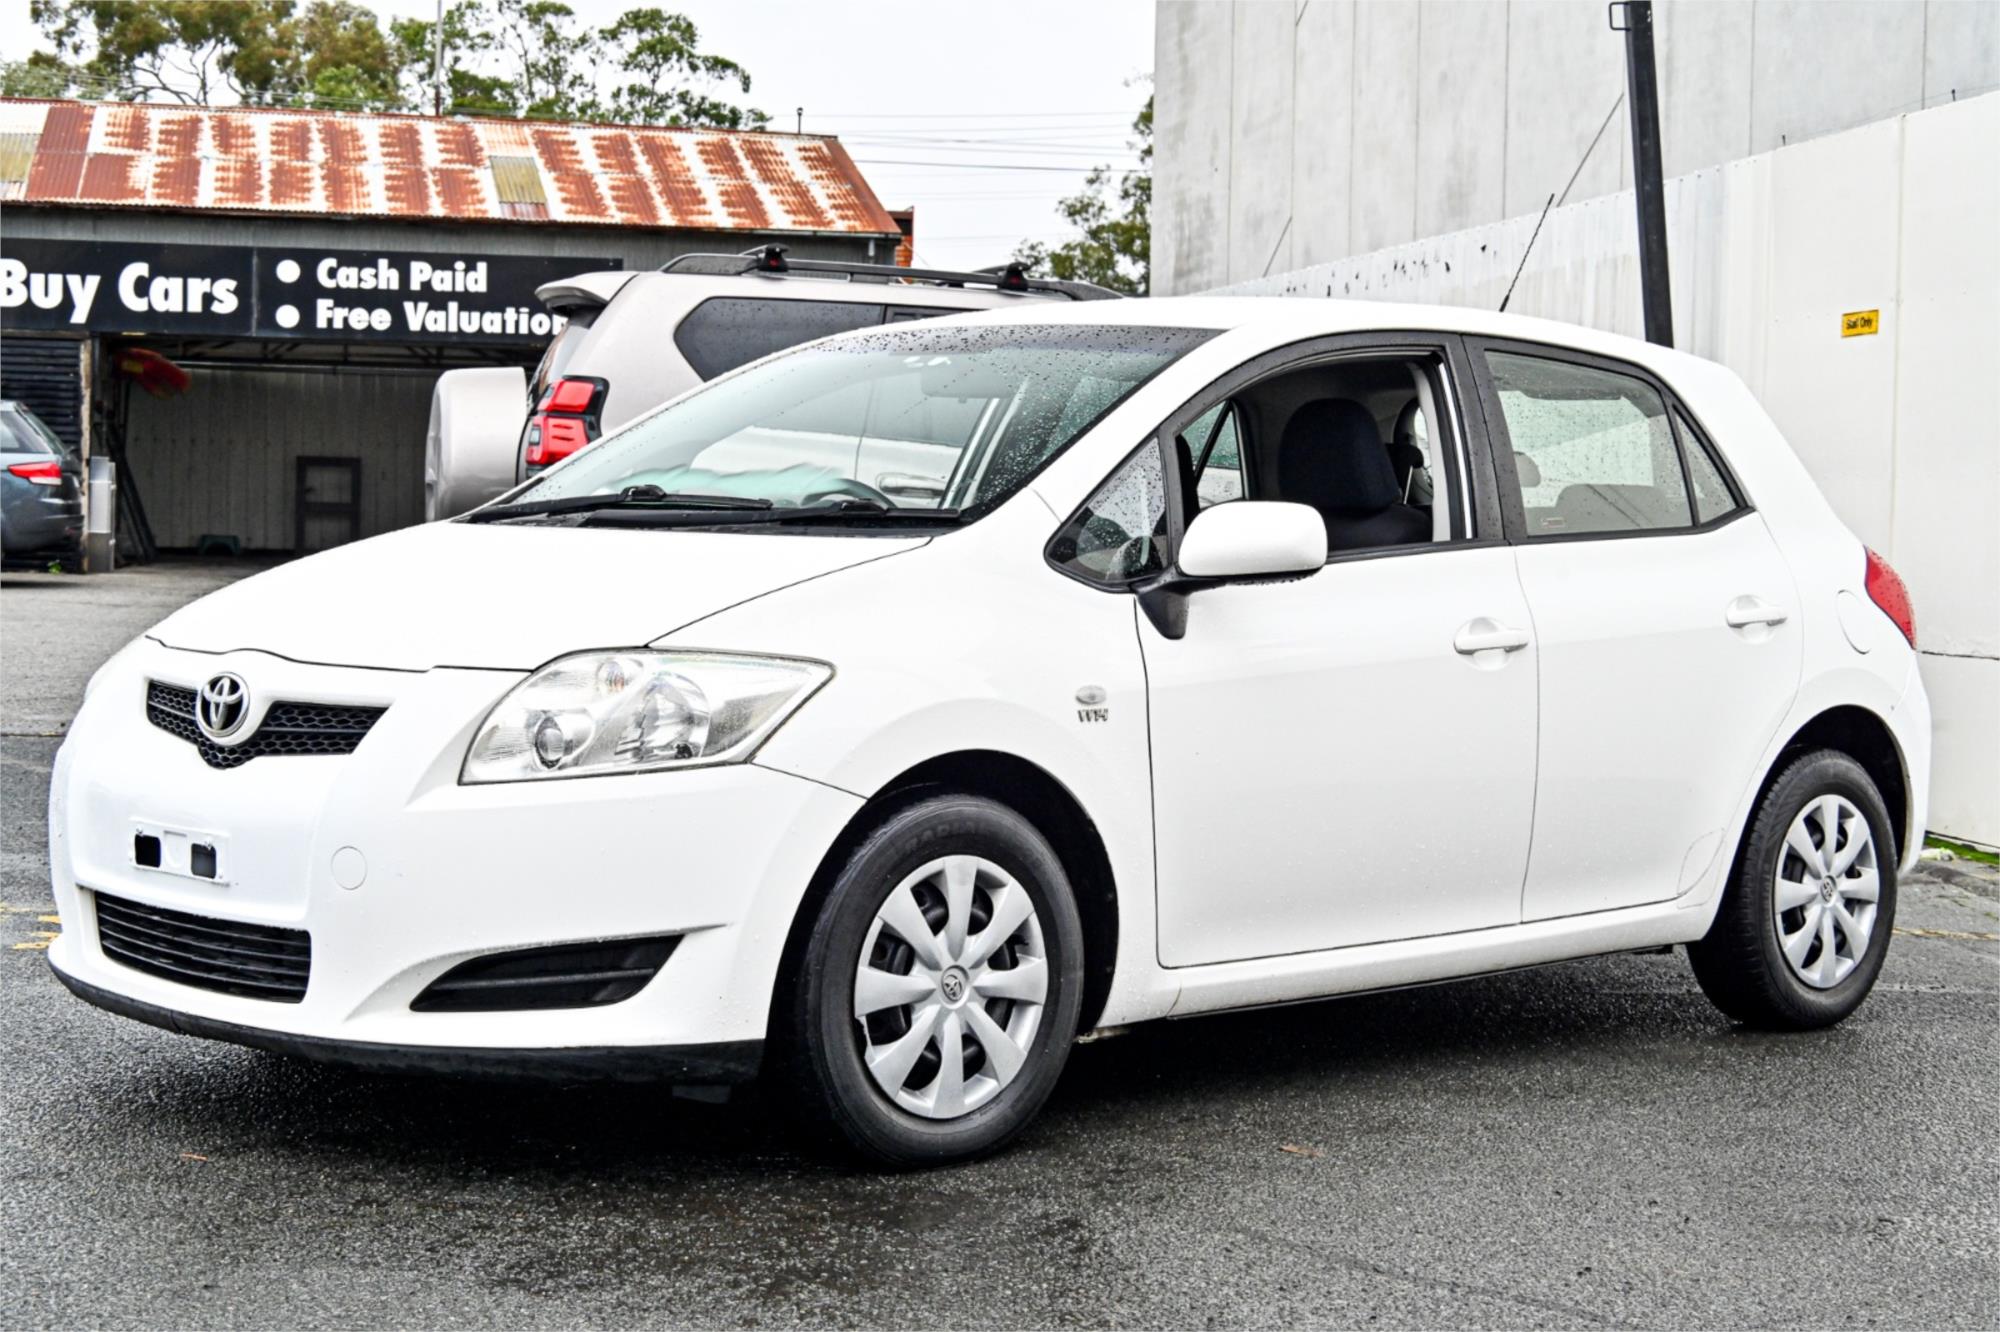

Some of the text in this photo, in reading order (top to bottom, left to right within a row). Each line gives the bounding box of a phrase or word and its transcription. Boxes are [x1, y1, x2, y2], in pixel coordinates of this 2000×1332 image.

[0, 258, 239, 324] Buy Cars
[316, 258, 487, 293] Cash Paid
[316, 299, 391, 330] Free
